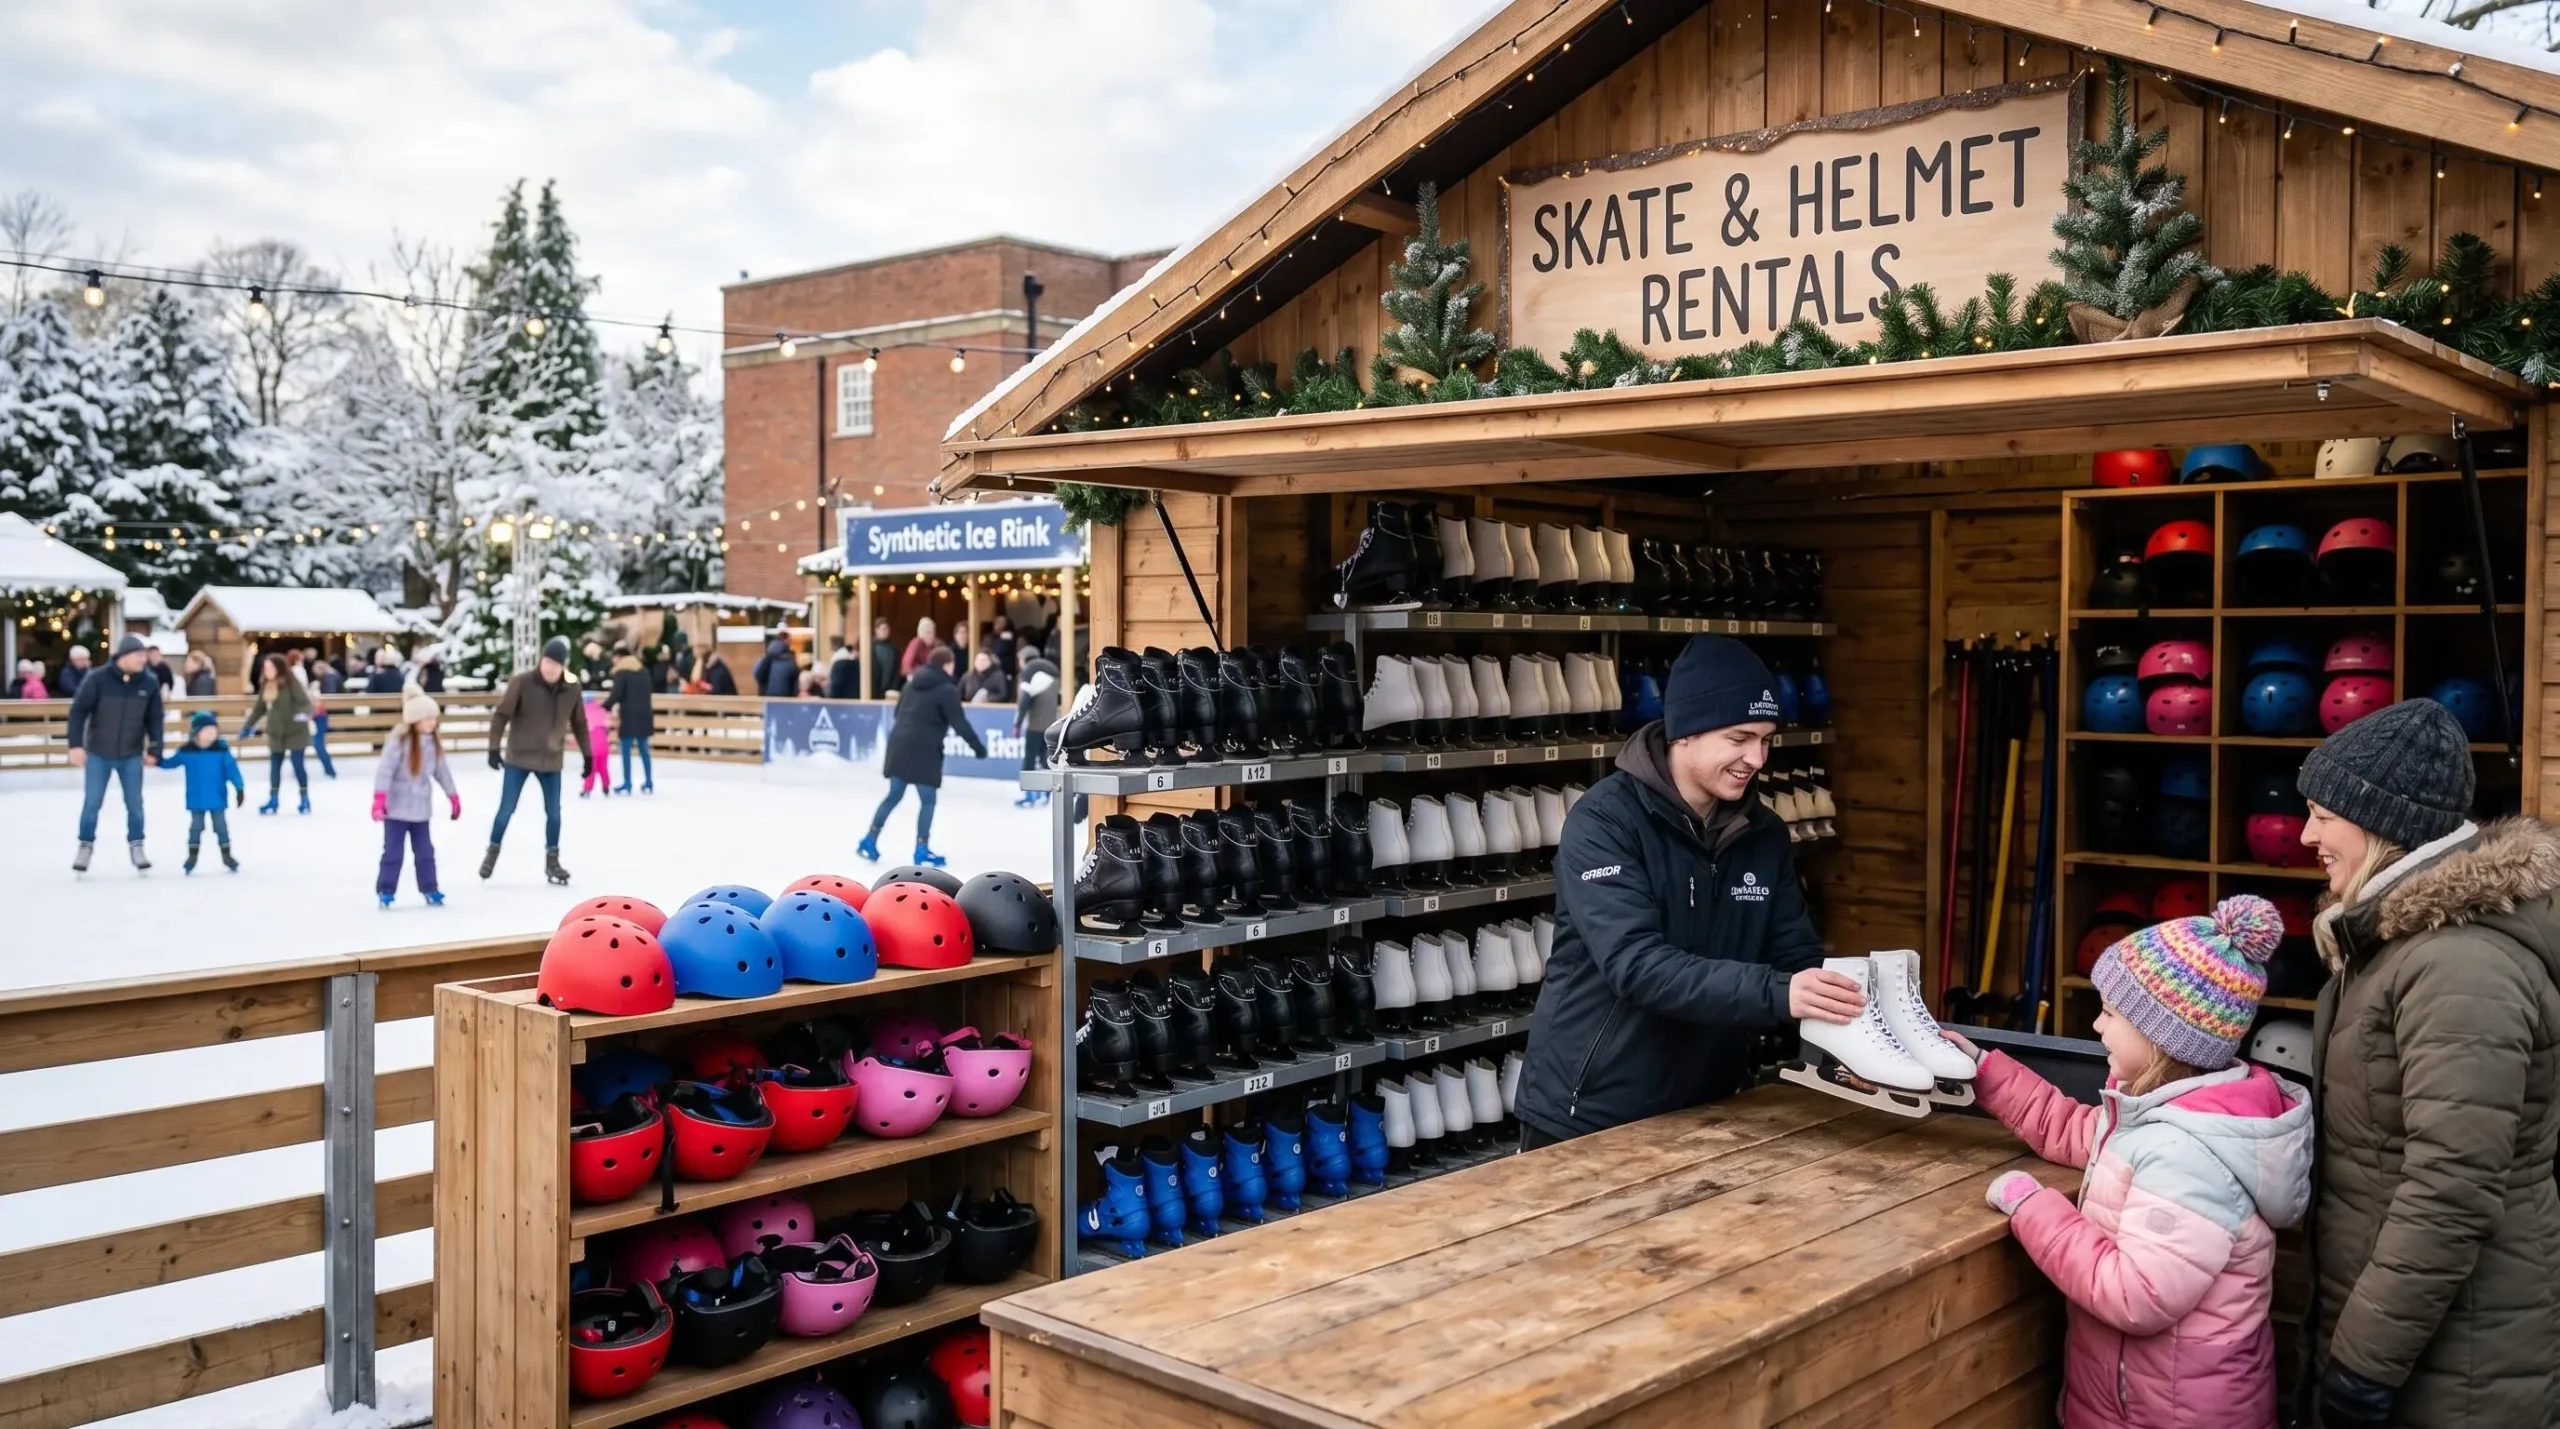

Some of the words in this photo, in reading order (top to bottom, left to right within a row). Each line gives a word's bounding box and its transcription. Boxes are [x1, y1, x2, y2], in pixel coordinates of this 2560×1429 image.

[1532, 182, 1693, 273] SKATE
[1721, 172, 1759, 247] &
[1790, 126, 2041, 238] HELMET
[1642, 243, 1901, 346] RENTALS
[868, 520, 962, 561] Synthetic
[965, 520, 997, 550] Ice
[1001, 515, 1051, 548] Rink
[1156, 775, 1164, 788] 6
[1252, 925, 1260, 937] 6
[1154, 942, 1162, 954] 6
